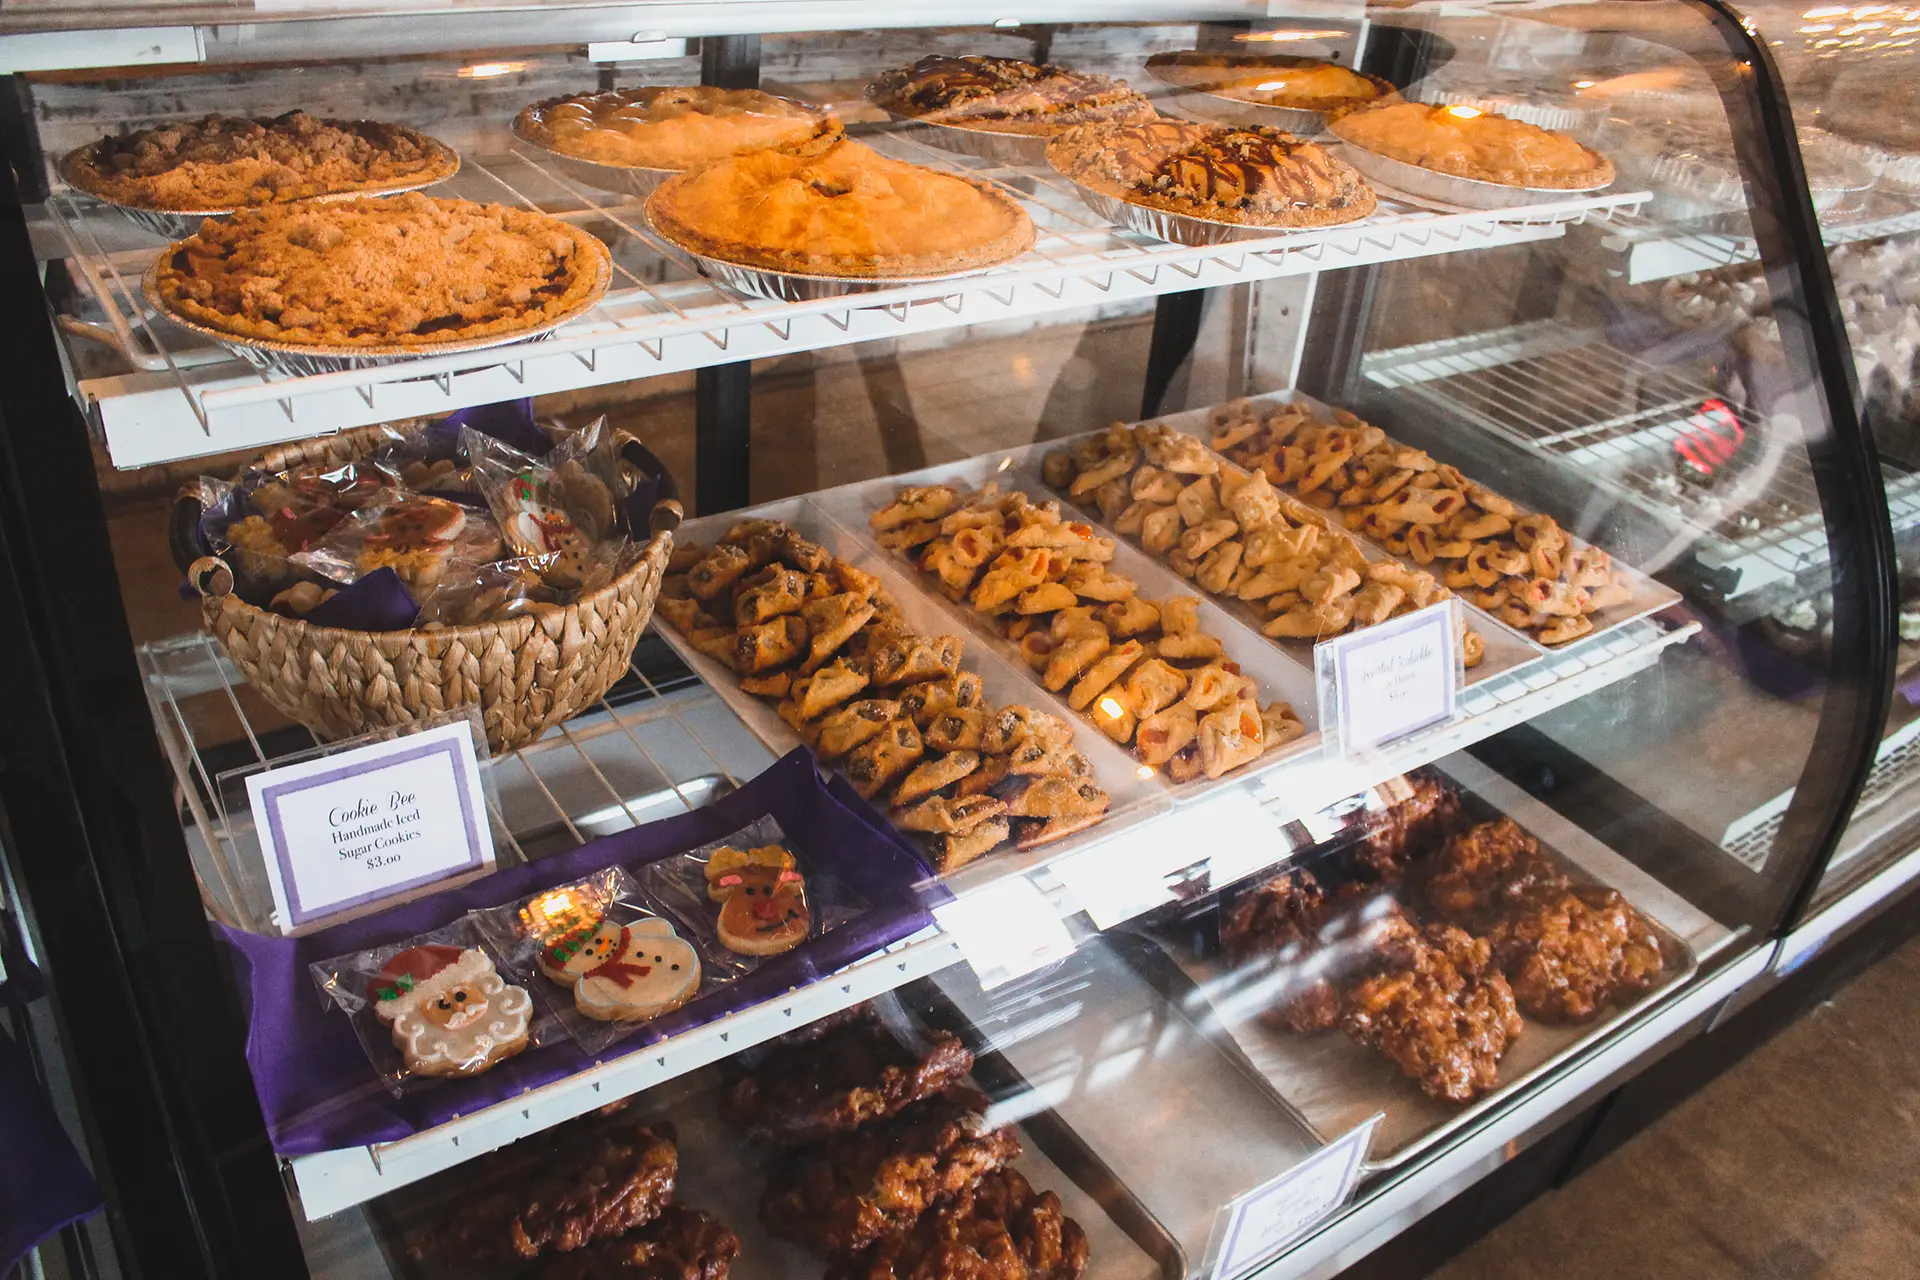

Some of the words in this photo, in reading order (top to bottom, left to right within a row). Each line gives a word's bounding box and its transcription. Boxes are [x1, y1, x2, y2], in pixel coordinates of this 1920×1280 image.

[328, 797, 378, 827] Cookie
[387, 790, 416, 811] Bee
[332, 818, 394, 844] Handmade
[396, 808, 420, 826] Iced
[338, 843, 373, 860] Sugar
[374, 830, 422, 850] Cookies
[366, 853, 401, 870] $3.00
